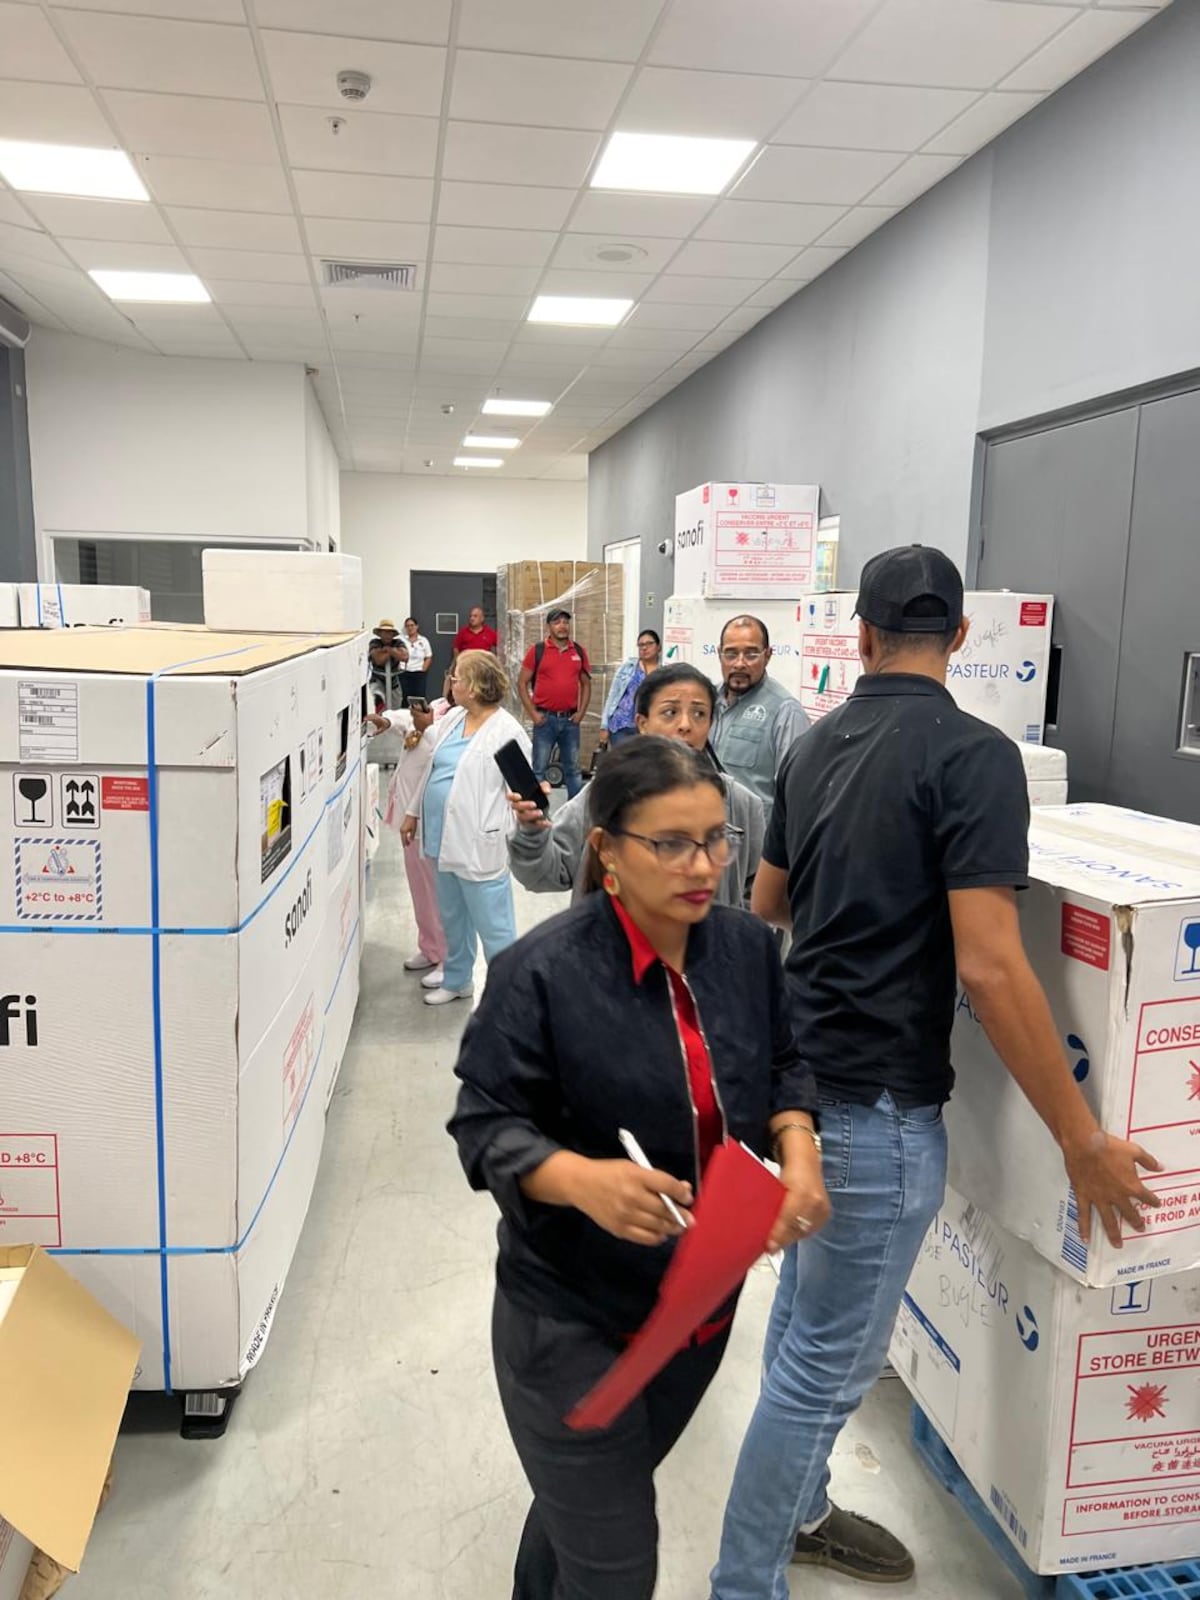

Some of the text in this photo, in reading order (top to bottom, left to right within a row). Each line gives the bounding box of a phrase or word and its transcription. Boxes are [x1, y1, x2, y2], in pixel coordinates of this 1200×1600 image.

[678, 519, 704, 550] sanofi
[945, 663, 1009, 679] PASTEUR
[25, 892, 94, 903] +2°C to +8°C
[285, 868, 312, 949] sanofi
[1146, 1025, 1200, 1046] CONSE
[15, 1153, 46, 1163] +8°C
[1155, 1210, 1185, 1223] FROID
[1117, 1265, 1136, 1275] MADE
[1146, 1258, 1171, 1269] FRANCE
[1090, 1347, 1200, 1371] STORE BETW
[1134, 1441, 1173, 1449] VACUNA
[1076, 1499, 1150, 1513] INFORMATION
[1154, 1496, 1168, 1504] TO
[1123, 1505, 1200, 1520] BEFORE STORA
[1089, 1552, 1116, 1561] FRANCE
